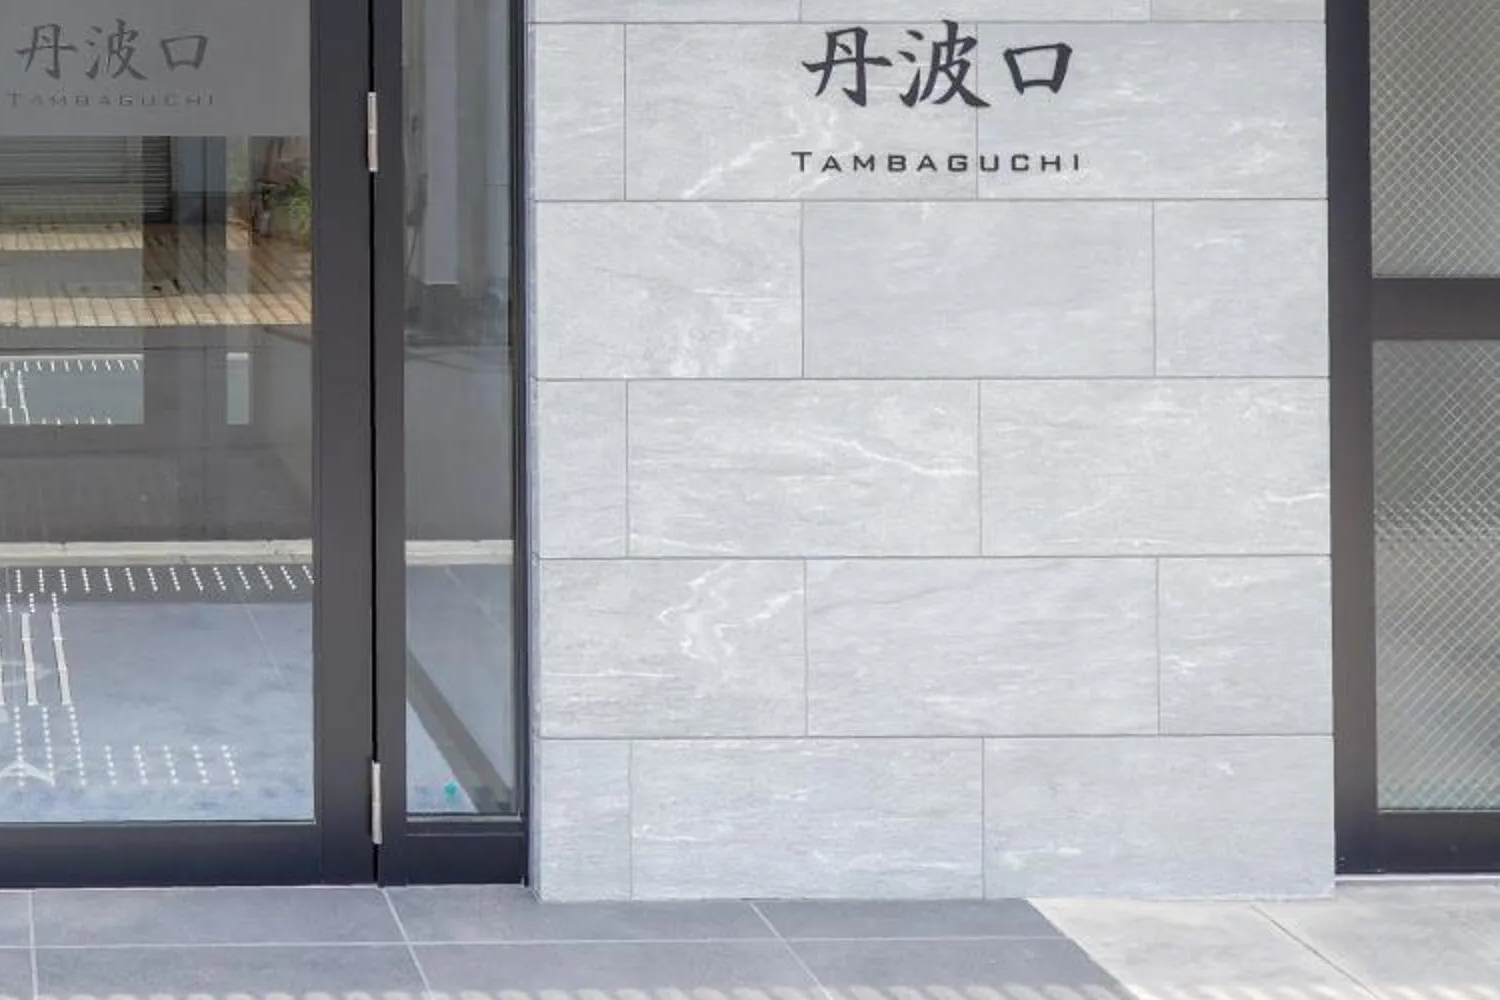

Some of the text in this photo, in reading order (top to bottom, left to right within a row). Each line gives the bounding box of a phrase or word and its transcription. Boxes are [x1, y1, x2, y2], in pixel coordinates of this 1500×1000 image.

[16, 18, 209, 81] 丹波口
[801, 20, 1073, 108] 丹波口
[791, 151, 1080, 173] TAMBAGUCHI
